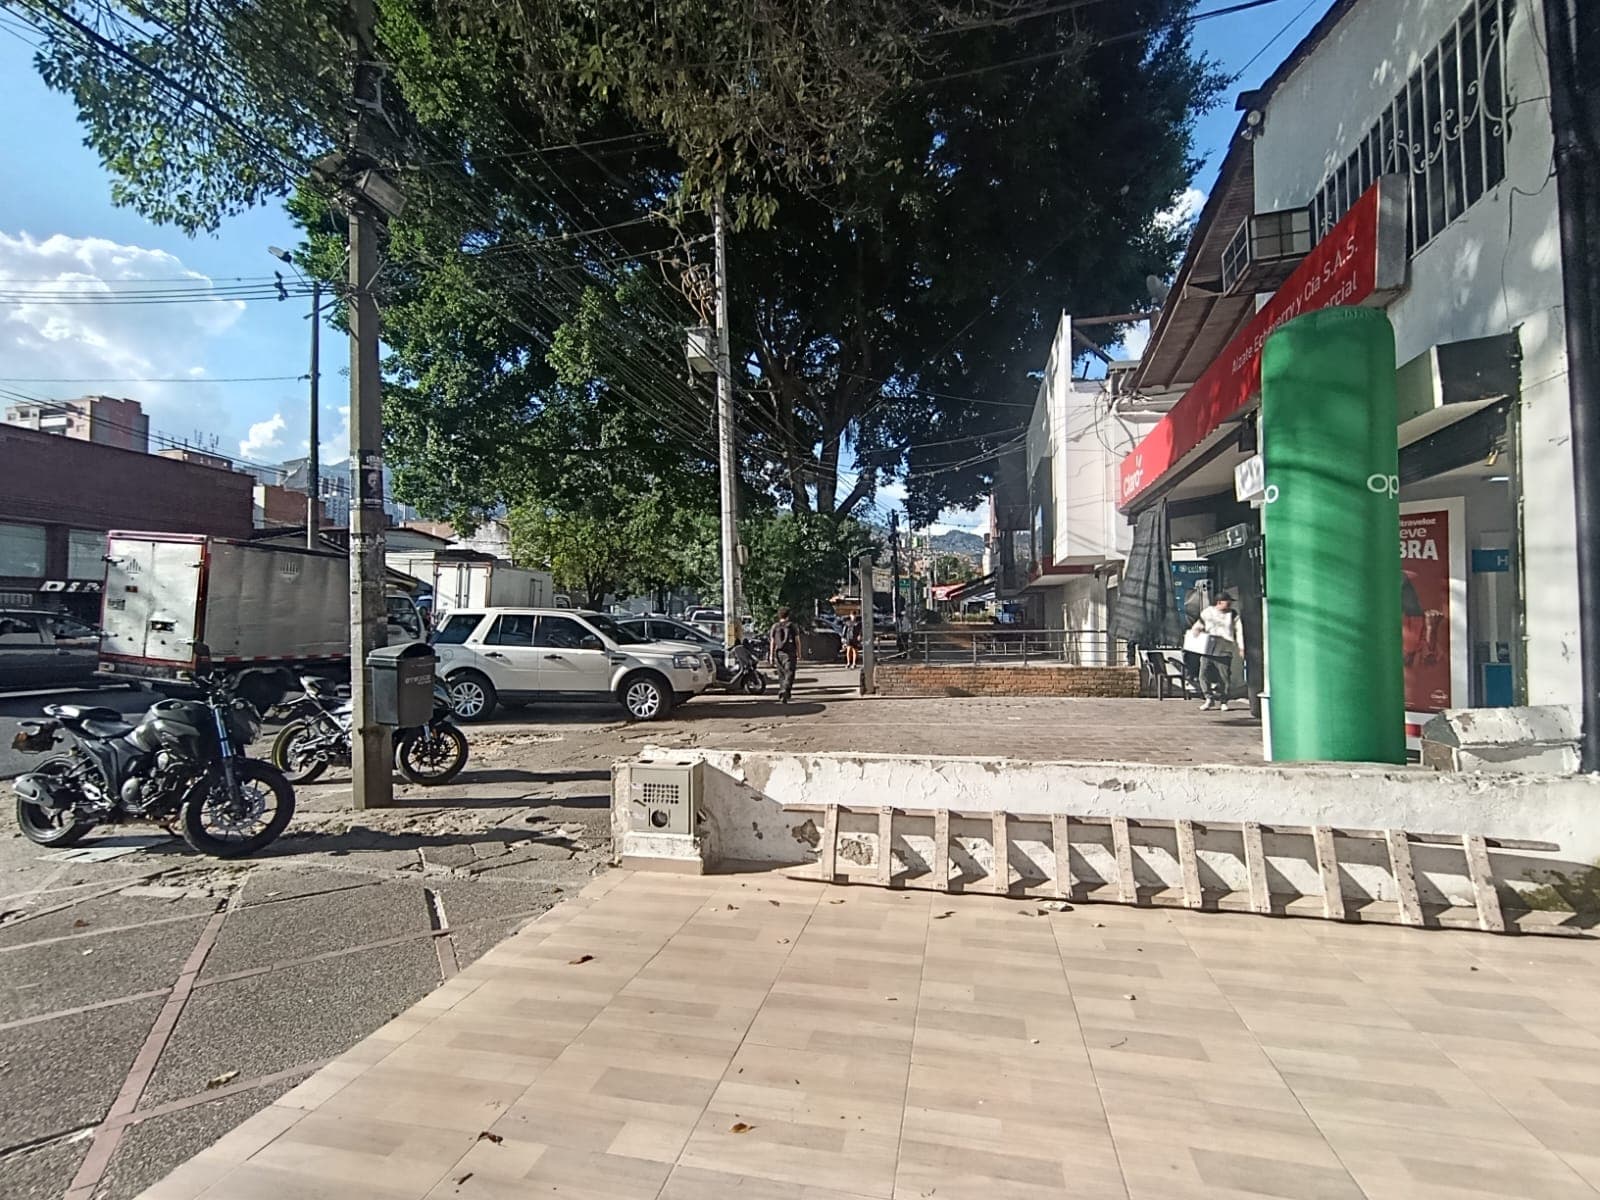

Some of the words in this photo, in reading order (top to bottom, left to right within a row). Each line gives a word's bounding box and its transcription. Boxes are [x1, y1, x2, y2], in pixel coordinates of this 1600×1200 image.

[1323, 270, 1358, 309] ercial
[1366, 473, 1399, 499] op
[1400, 527, 1427, 539] eve
[1399, 539, 1439, 561] BRA
